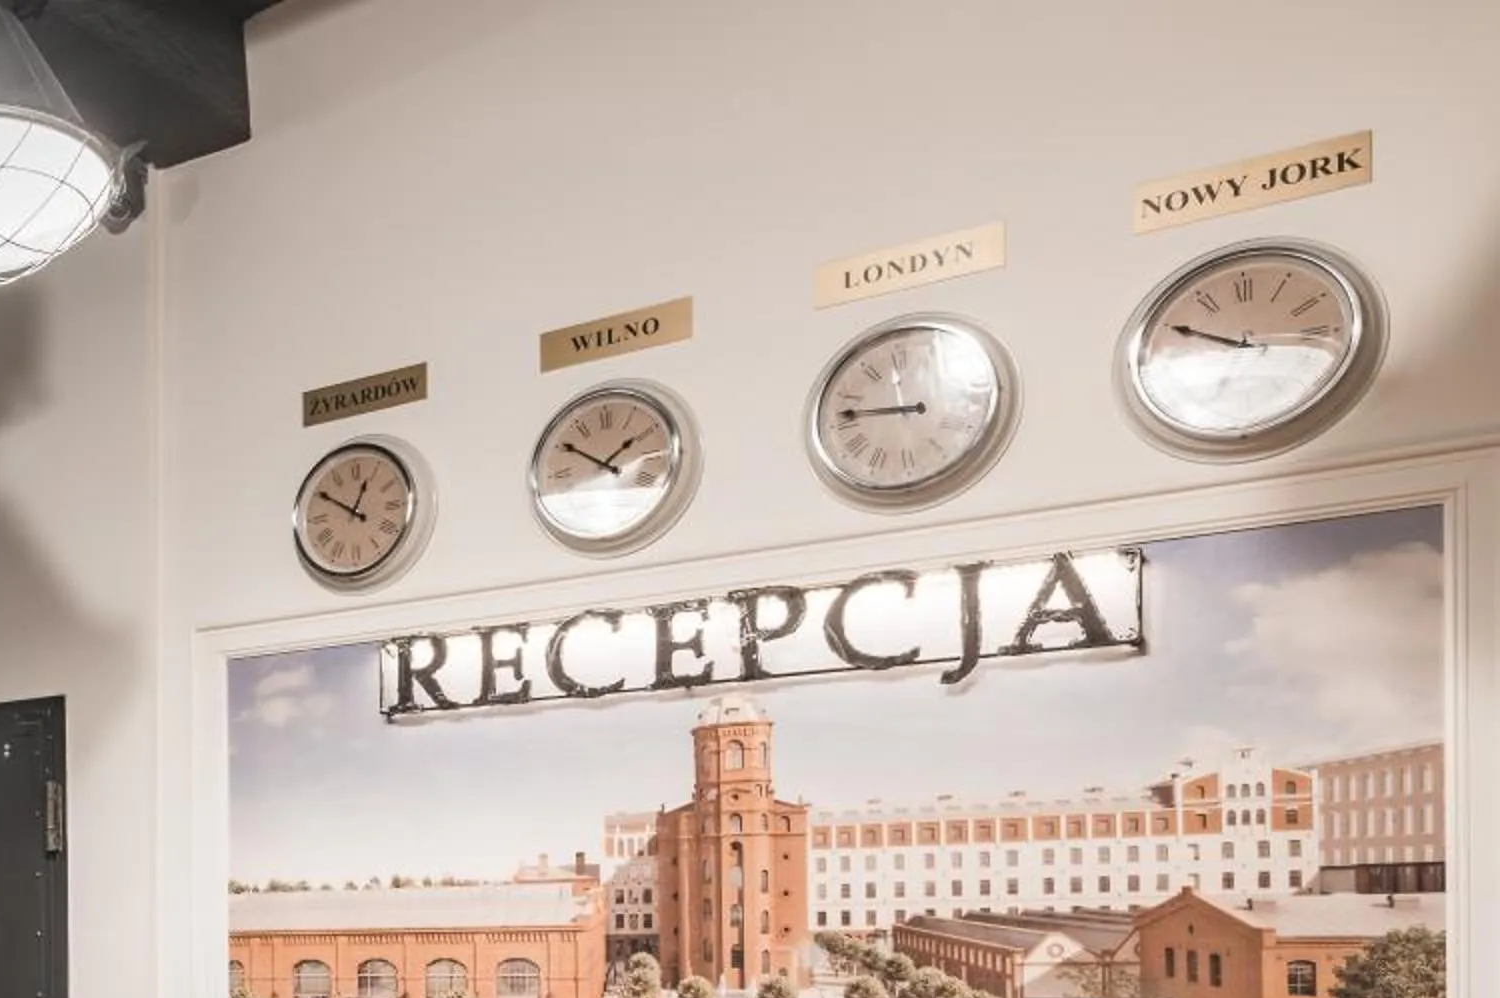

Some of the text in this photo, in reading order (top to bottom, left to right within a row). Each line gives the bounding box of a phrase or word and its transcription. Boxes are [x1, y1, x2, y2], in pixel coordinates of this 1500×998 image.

[1142, 148, 1364, 218] NOWY JORK
[844, 241, 975, 289] LONDYN
[571, 317, 660, 352] WILNO
[392, 551, 1122, 712] RECEPCJA
